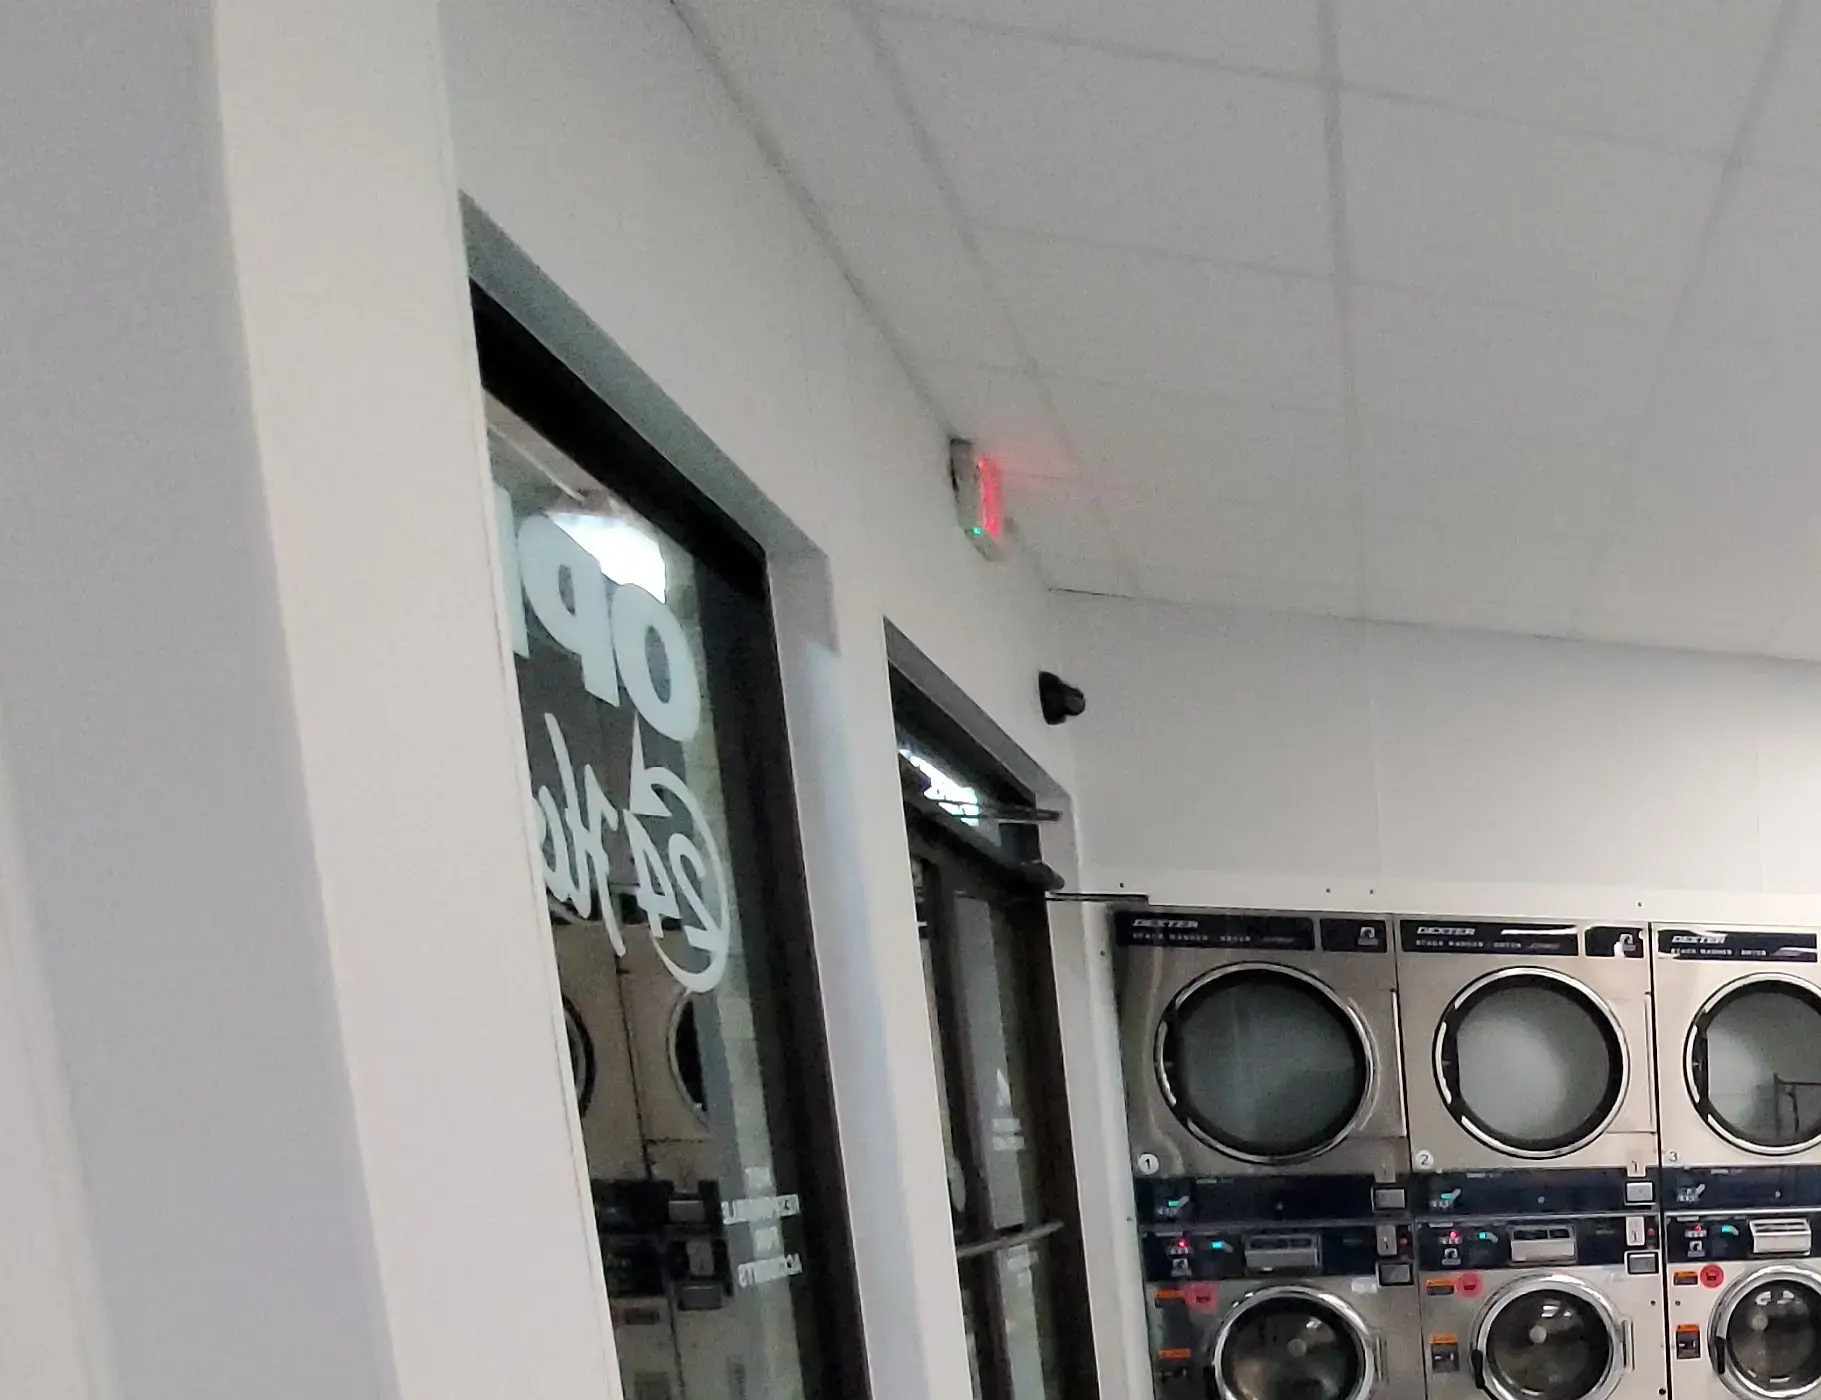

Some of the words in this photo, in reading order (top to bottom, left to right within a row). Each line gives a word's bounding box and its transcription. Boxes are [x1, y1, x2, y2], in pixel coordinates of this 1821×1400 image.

[1416, 926, 1476, 936] DEXTER
[1420, 1154, 1429, 1166] 2
[1668, 1151, 1678, 1162] 3
